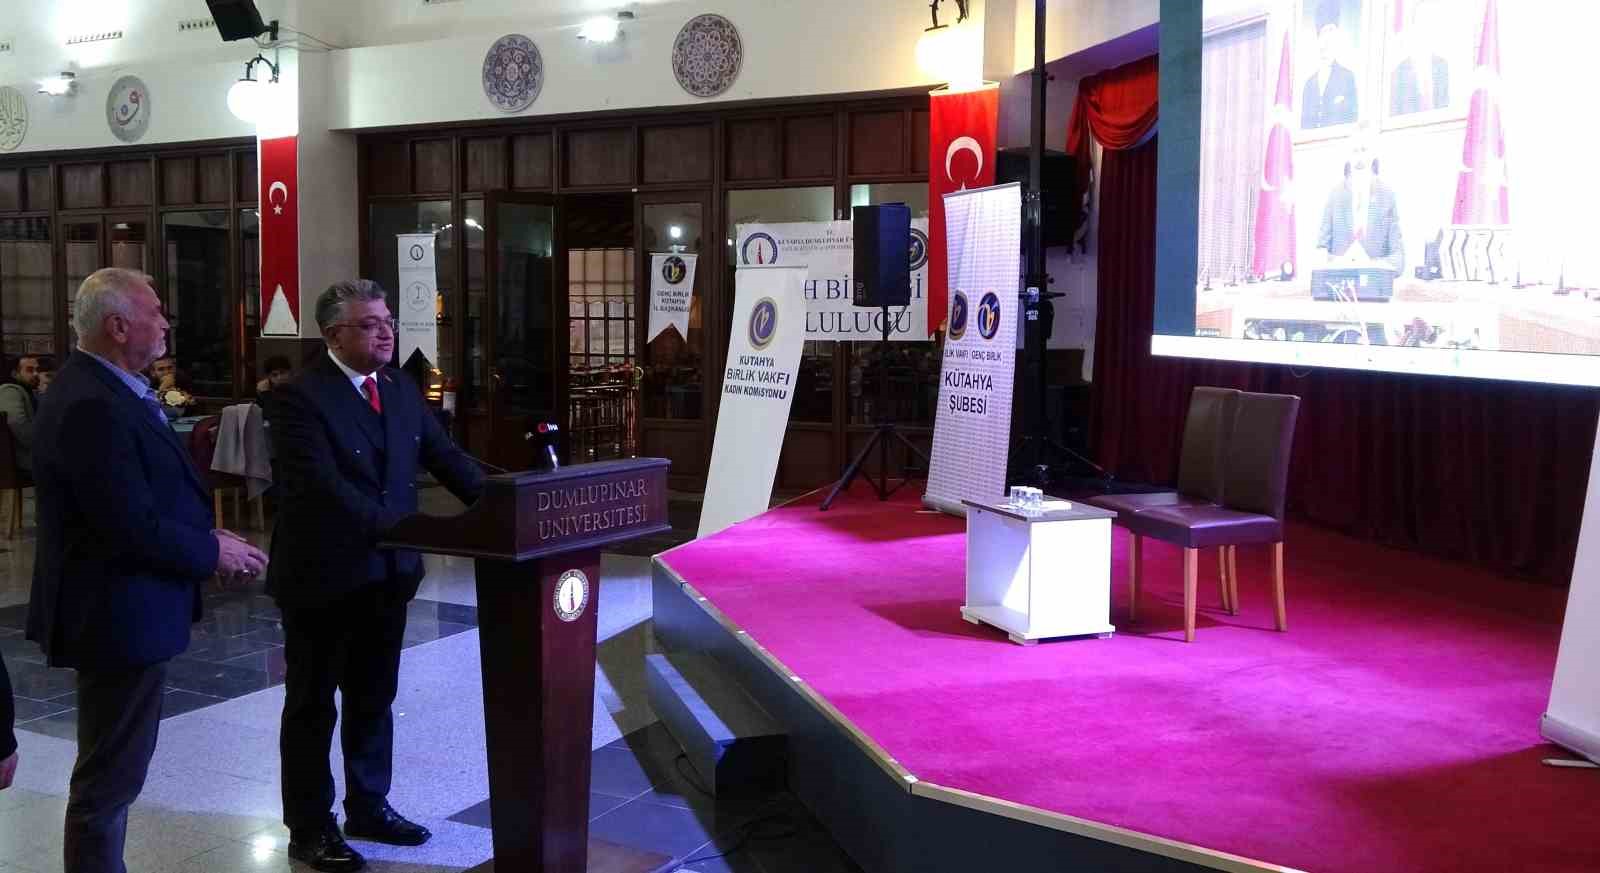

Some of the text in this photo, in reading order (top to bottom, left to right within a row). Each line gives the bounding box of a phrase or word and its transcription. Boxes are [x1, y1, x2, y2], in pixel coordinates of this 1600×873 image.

[757, 370, 790, 385] VAKFI
[945, 368, 993, 391] KÜTAHYA
[724, 384, 742, 395] KADIN
[949, 394, 988, 415] ŞUBESİ
[536, 479, 649, 512] DUMLUPINAR
